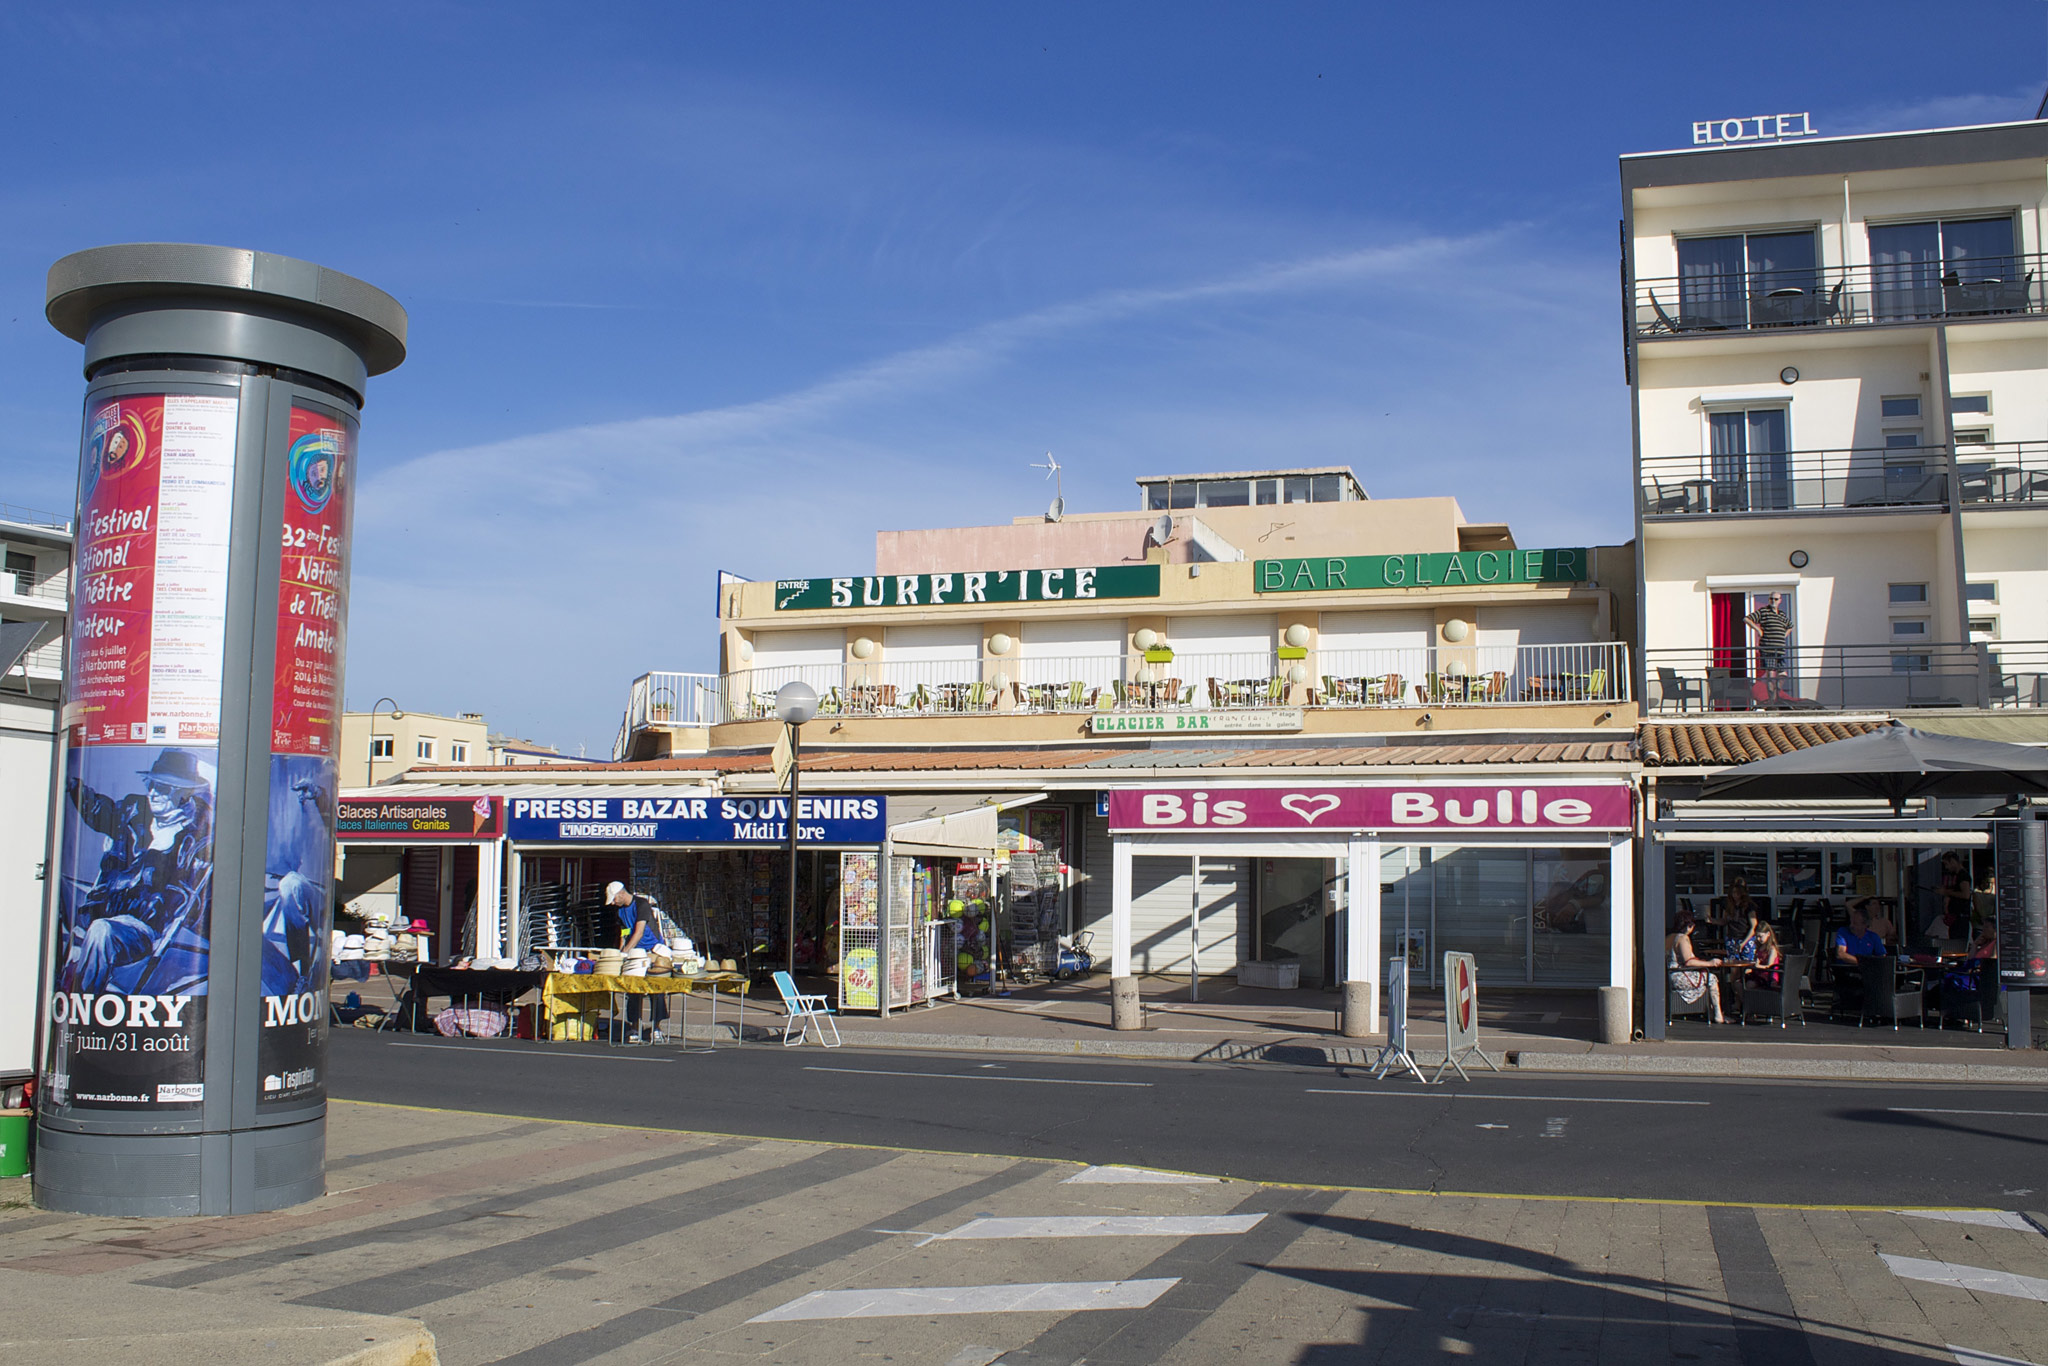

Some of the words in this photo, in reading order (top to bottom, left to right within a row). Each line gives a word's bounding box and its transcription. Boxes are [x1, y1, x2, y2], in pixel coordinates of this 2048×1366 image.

[1692, 112, 1818, 144] HOTEL
[88, 505, 152, 540] Festival
[82, 540, 131, 572] ational
[1264, 558, 1347, 589] BAR
[1382, 549, 1577, 586] GLACIER
[831, 568, 1096, 607] SURPR'ICE
[290, 593, 305, 614] de
[77, 613, 125, 638] mateur
[105, 644, 127, 657] juillet
[85, 658, 126, 673] Narbonne
[1096, 716, 1165, 730] GLACIER
[1176, 715, 1209, 729] BAR
[337, 804, 378, 819] Glaces
[380, 804, 447, 819] Artisanales
[515, 799, 607, 819] PRESSE
[623, 800, 707, 819] BAZAR
[721, 799, 878, 820] SOUVENIRS
[1142, 792, 1247, 825] Bis
[1391, 789, 1593, 825] Bulle
[338, 820, 362, 830] laces
[365, 819, 408, 830] Italiennes
[412, 818, 450, 830] Granitas
[733, 822, 775, 839] Midi
[777, 822, 825, 840] Lbre
[76, 1031, 107, 1053] juin
[143, 1033, 190, 1052] août
[76, 1092, 150, 1103] www.narbonne.fr
[158, 1083, 202, 1094] Narbonne
